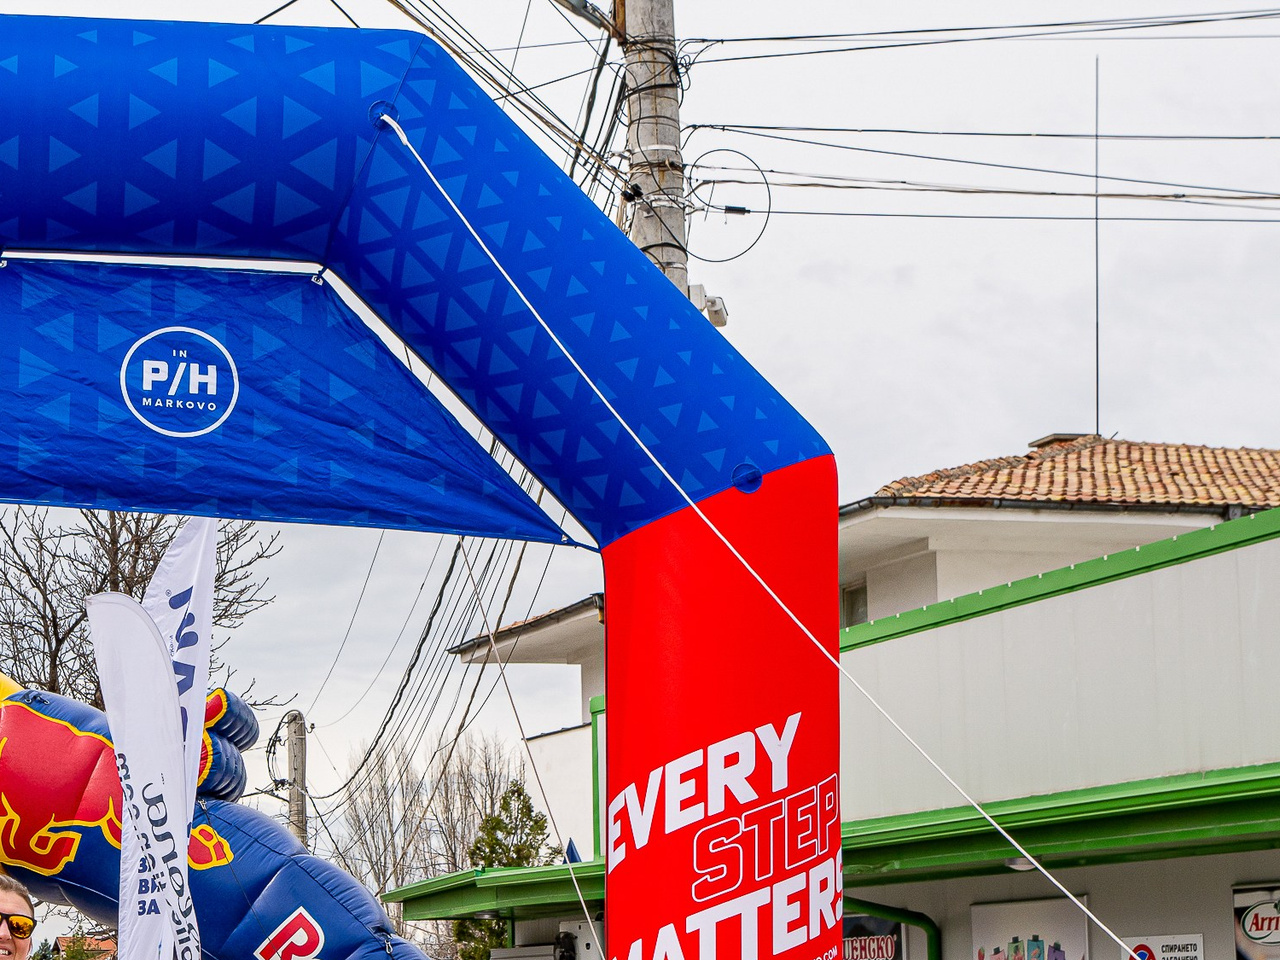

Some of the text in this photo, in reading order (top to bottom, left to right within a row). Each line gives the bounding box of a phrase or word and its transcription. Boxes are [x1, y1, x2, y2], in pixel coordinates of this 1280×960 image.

[172, 349, 187, 358] IN
[142, 360, 217, 396] P/H
[142, 397, 216, 411] MARKOVO
[608, 711, 802, 875] EVERY
[691, 772, 840, 903] STEP
